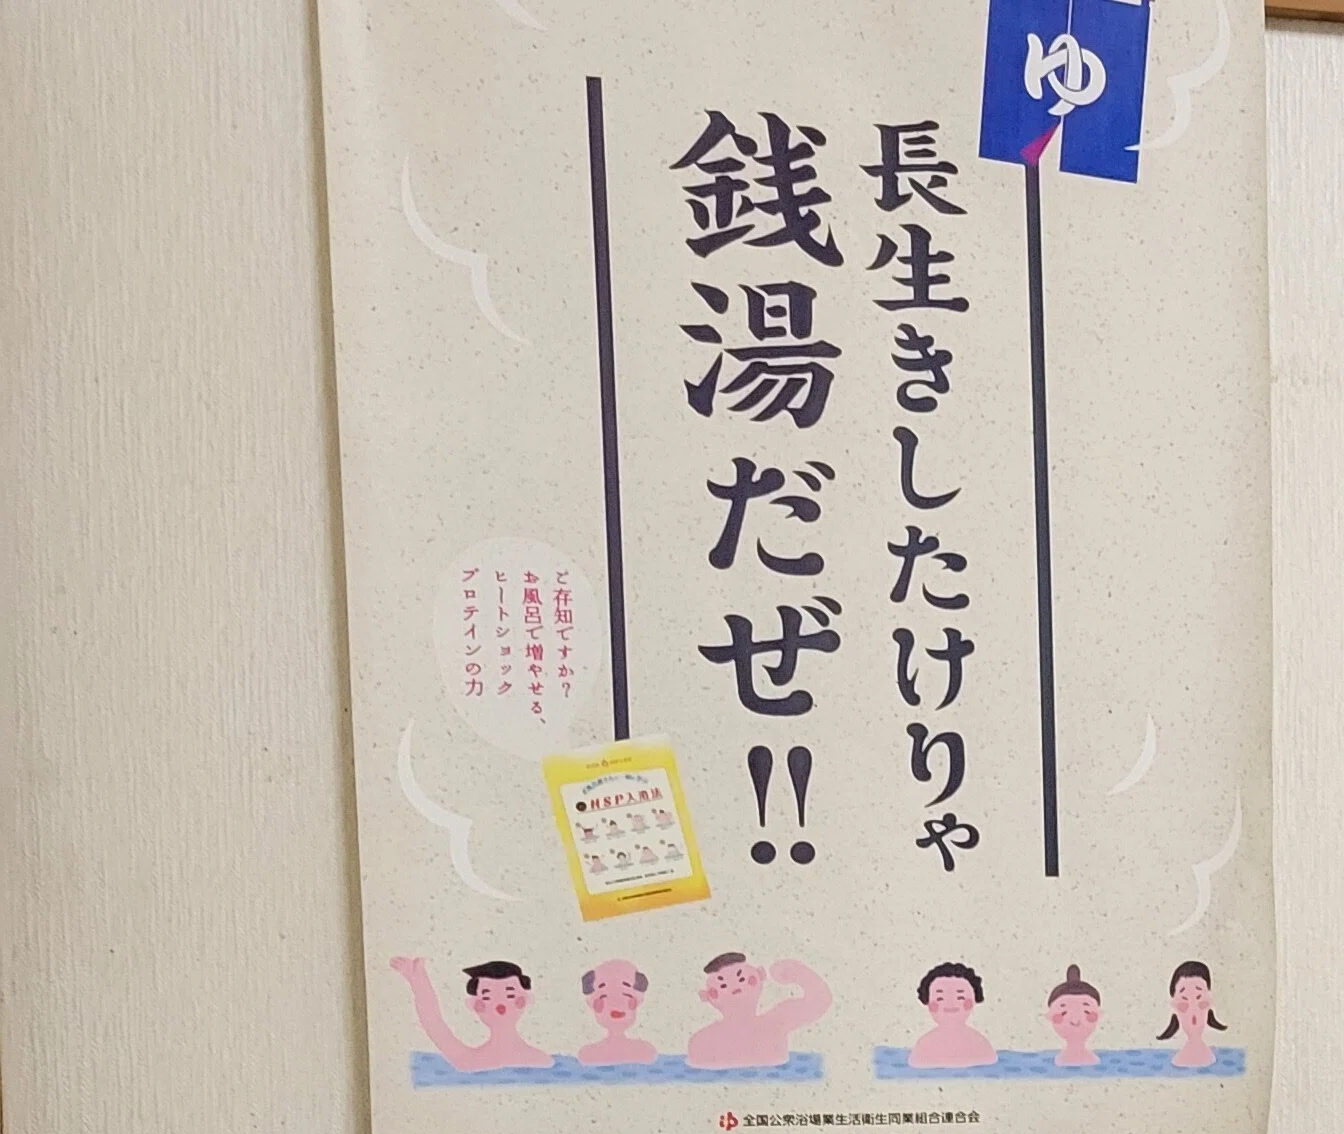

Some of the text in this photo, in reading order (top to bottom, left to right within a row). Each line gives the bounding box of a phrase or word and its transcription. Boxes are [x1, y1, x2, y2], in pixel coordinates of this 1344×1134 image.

[1022, 32, 1107, 118] ゆ
[859, 120, 981, 873] 長生きしたけりゃ
[461, 567, 485, 698] プロテインの力
[495, 569, 514, 696] ヒートショック
[522, 569, 548, 725] お風呂で増やせる、
[552, 569, 575, 699] ご存知ですか?
